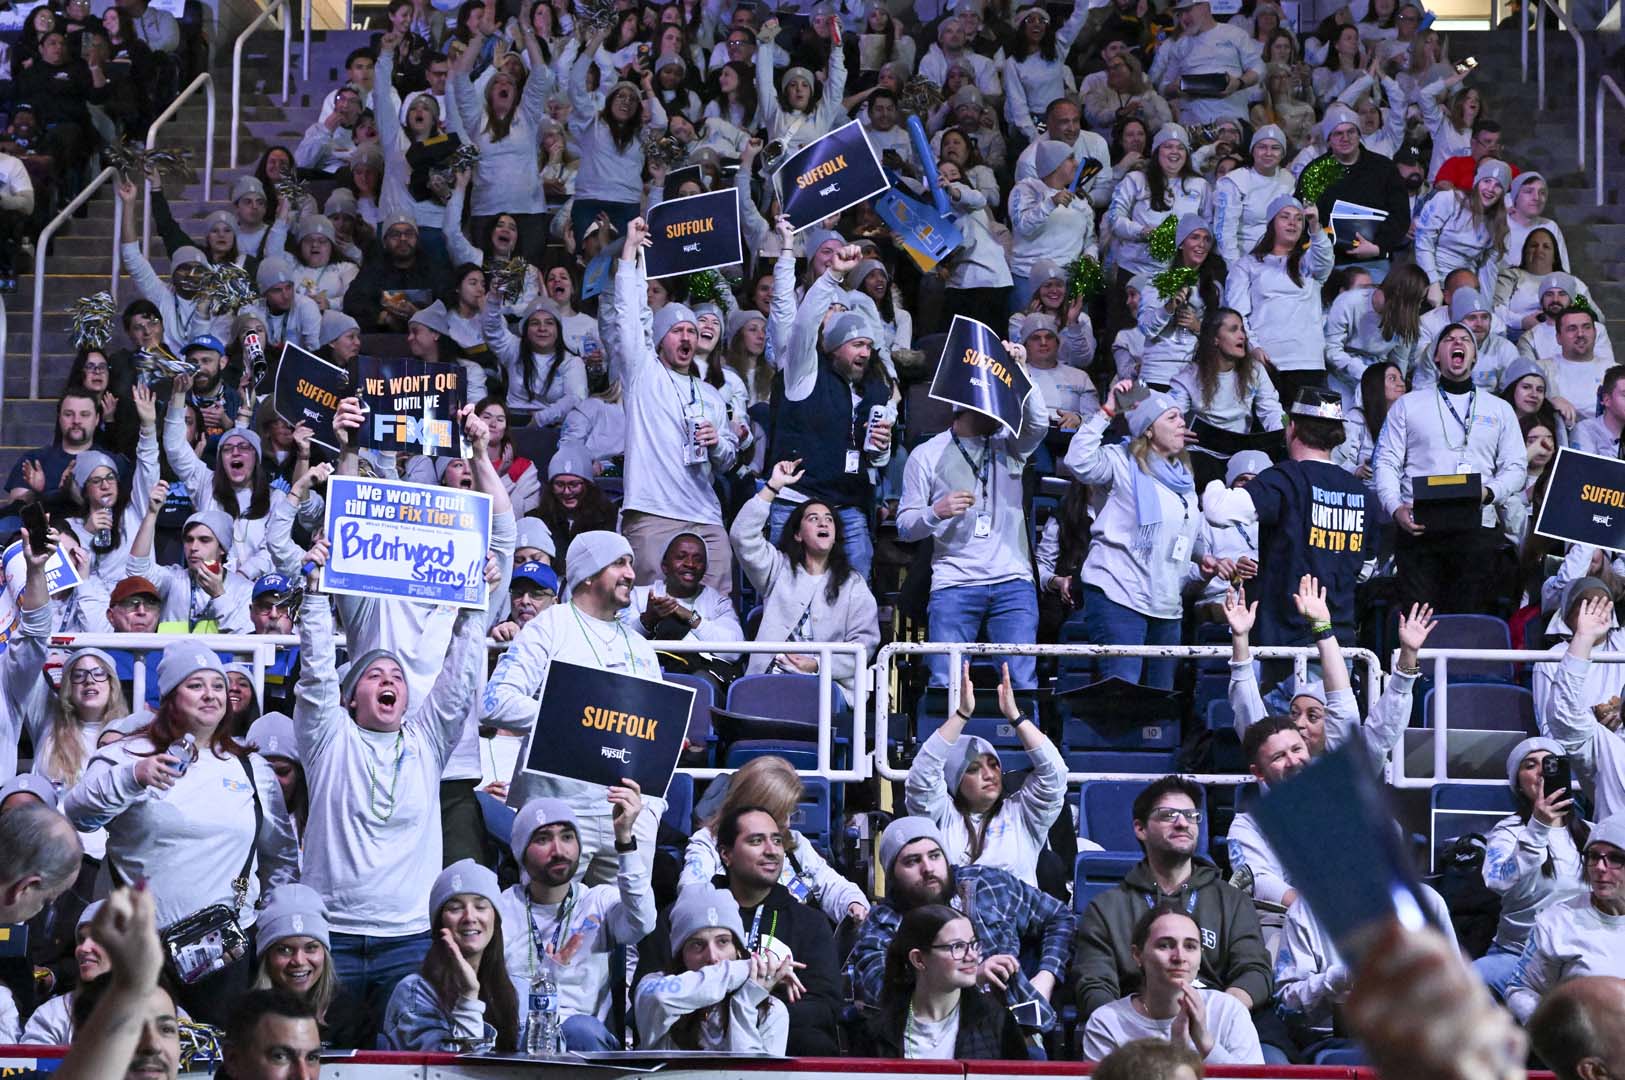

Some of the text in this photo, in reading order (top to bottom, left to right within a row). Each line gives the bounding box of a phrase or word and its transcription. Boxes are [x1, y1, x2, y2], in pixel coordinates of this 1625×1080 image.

[796, 154, 848, 189] SUFFOLK
[666, 217, 714, 239] SUFFOLK
[962, 348, 1013, 390] SUFFOLK
[296, 379, 338, 410] SUFFOL
[366, 378, 384, 396] WE
[390, 375, 430, 395] WON'T
[394, 395, 439, 411] UNTIL WE
[357, 484, 465, 512] We won't quit
[1581, 484, 1625, 508] SUFFOL
[345, 499, 366, 516] till
[371, 506, 395, 518] we
[400, 505, 422, 521] Fix
[426, 508, 456, 526] Tier
[341, 521, 454, 567] Brentwood
[1349, 533, 1363, 552] 6!
[411, 560, 480, 590] Strong!!
[581, 705, 658, 741] SUFFOLK
[1003, 726, 1010, 735] 9
[1147, 728, 1157, 737] 10
